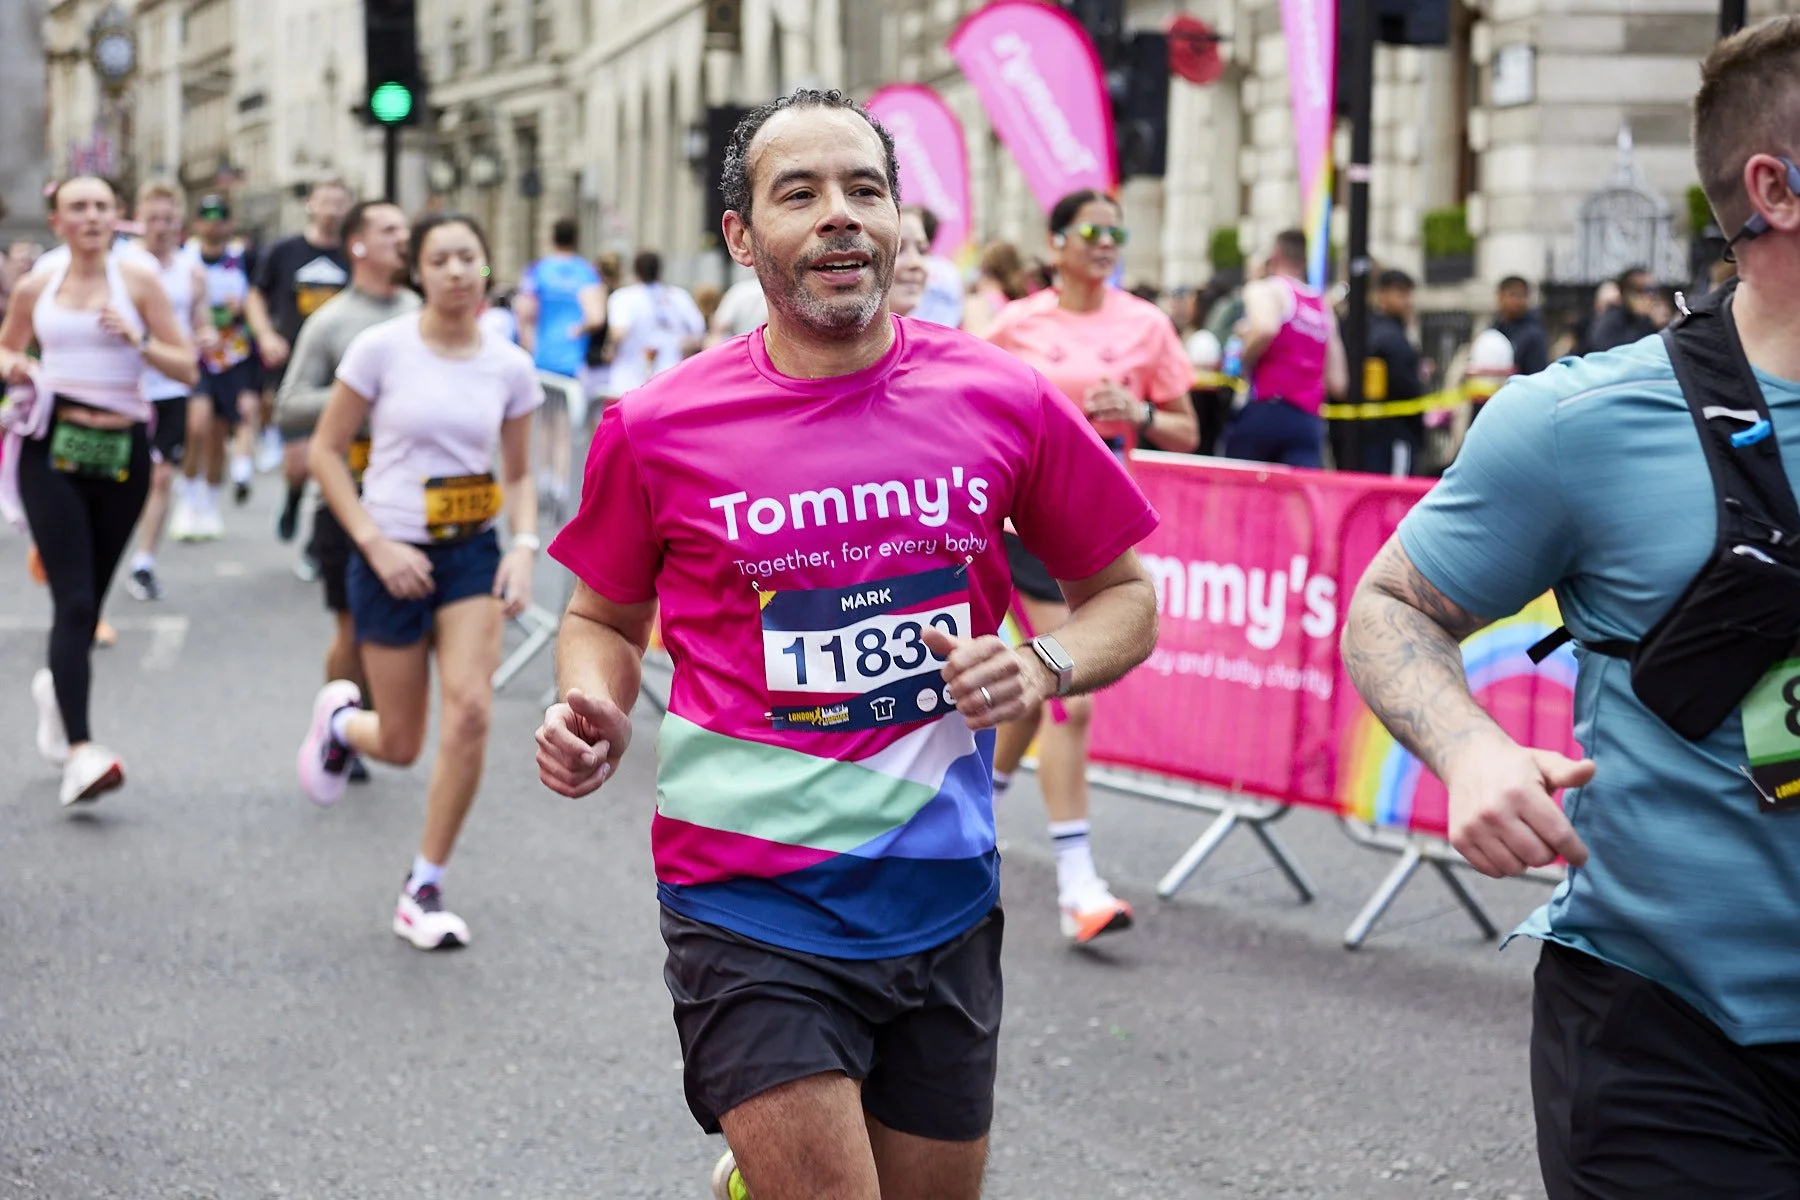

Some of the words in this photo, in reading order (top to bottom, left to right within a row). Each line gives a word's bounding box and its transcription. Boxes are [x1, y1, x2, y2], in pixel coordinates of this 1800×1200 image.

[709, 467, 989, 541] Tommy's
[733, 549, 835, 577] Together,
[841, 542, 871, 563] for
[878, 539, 937, 557] every
[945, 532, 987, 553] baby
[841, 587, 892, 611] MARK
[1140, 553, 1337, 650] mmy's
[788, 711, 815, 722] LONDON
